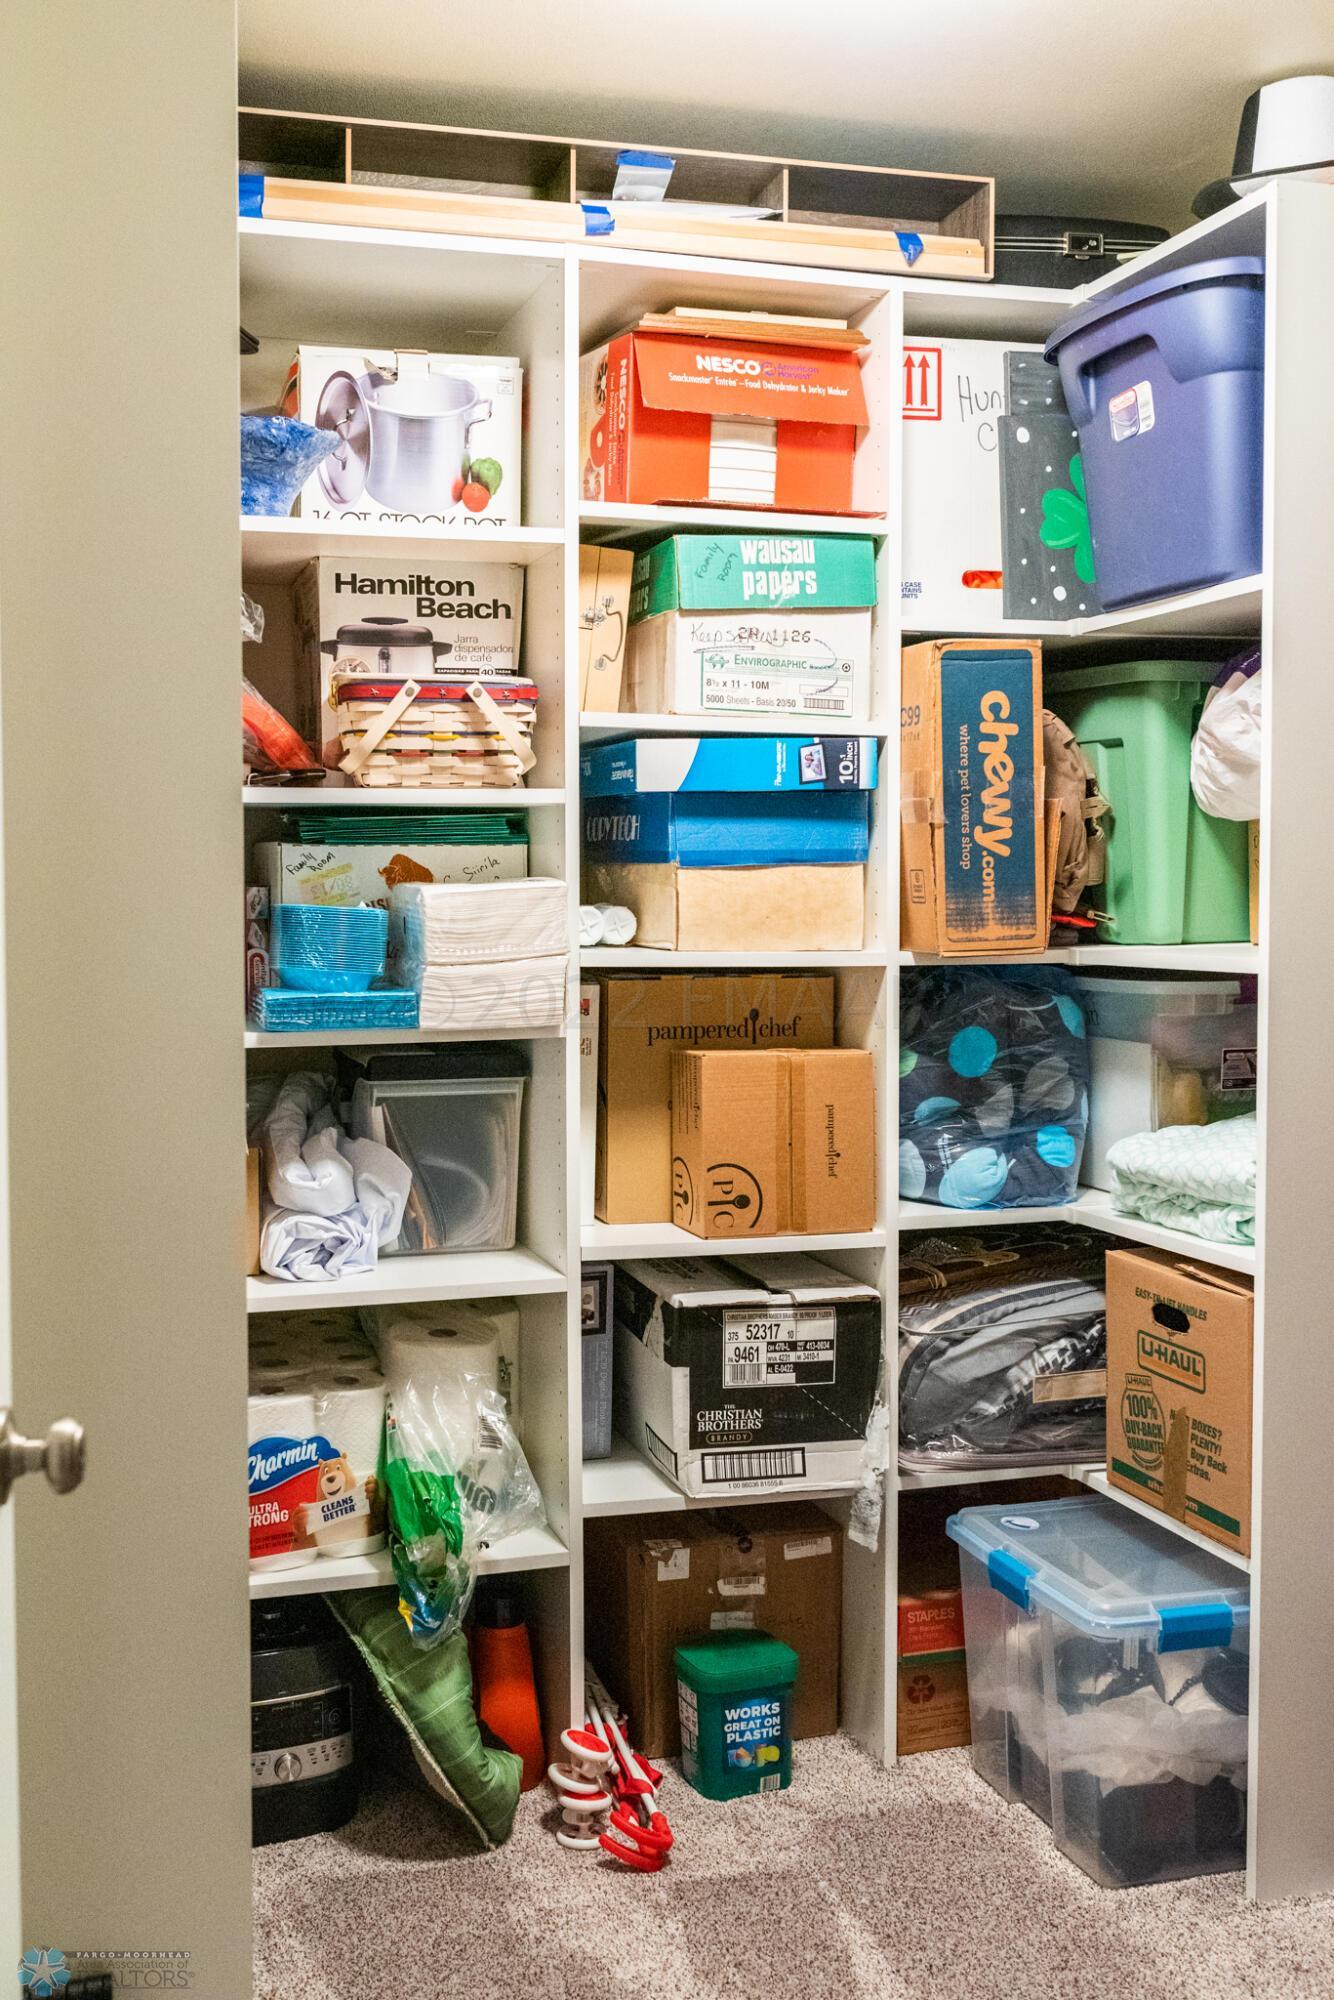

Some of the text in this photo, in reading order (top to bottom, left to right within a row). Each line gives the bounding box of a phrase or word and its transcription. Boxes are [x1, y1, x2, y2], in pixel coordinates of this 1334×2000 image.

[695, 355, 760, 376] NESCO
[618, 358, 628, 430] NESCO
[762, 381, 799, 393] Dehydrator
[808, 385, 826, 396] Jerky
[828, 387, 849, 397] Maker
[958, 375, 1003, 422] Hun
[739, 540, 815, 564] wausau
[335, 573, 475, 597] Hamilton
[742, 571, 818, 600] papers
[416, 597, 512, 619] Beach
[454, 634, 479, 644] Jarra
[454, 643, 513, 655] dispensador
[454, 653, 492, 663] de café
[731, 679, 740, 689] 11
[751, 681, 770, 690] 10M
[706, 694, 724, 704] 5000
[726, 695, 750, 705] Sheets
[756, 697, 775, 707] Basis
[959, 724, 971, 871] where pet lovers shop
[648, 1015, 801, 1046] pampered chef
[825, 1104, 838, 1179] pampered chef
[728, 1332, 739, 1342] 375
[746, 1323, 781, 1340] 52317
[734, 1346, 760, 1363] 9461
[1141, 1337, 1201, 1377] U-HAUL
[696, 1409, 763, 1422] CHRISTIAN
[1126, 1394, 1157, 1420] 100%
[697, 1420, 763, 1432] BROTHERS
[1125, 1418, 1163, 1439] BUY-BACK
[1191, 1419, 1223, 1441] BOXES?
[710, 1433, 748, 1442] BRANDY
[1190, 1433, 1222, 1457] PLENTY!
[248, 1440, 318, 1484] Charmin
[1190, 1448, 1228, 1475] Buy Back
[321, 1496, 354, 1514] CLEANS
[323, 1504, 356, 1523] BETTER
[249, 1510, 289, 1528] TRONG
[907, 1607, 956, 1624] STAPLES
[725, 1702, 781, 1721] WORKS
[724, 1715, 781, 1733] GREAT ON
[727, 1726, 781, 1743] PLASTIC
